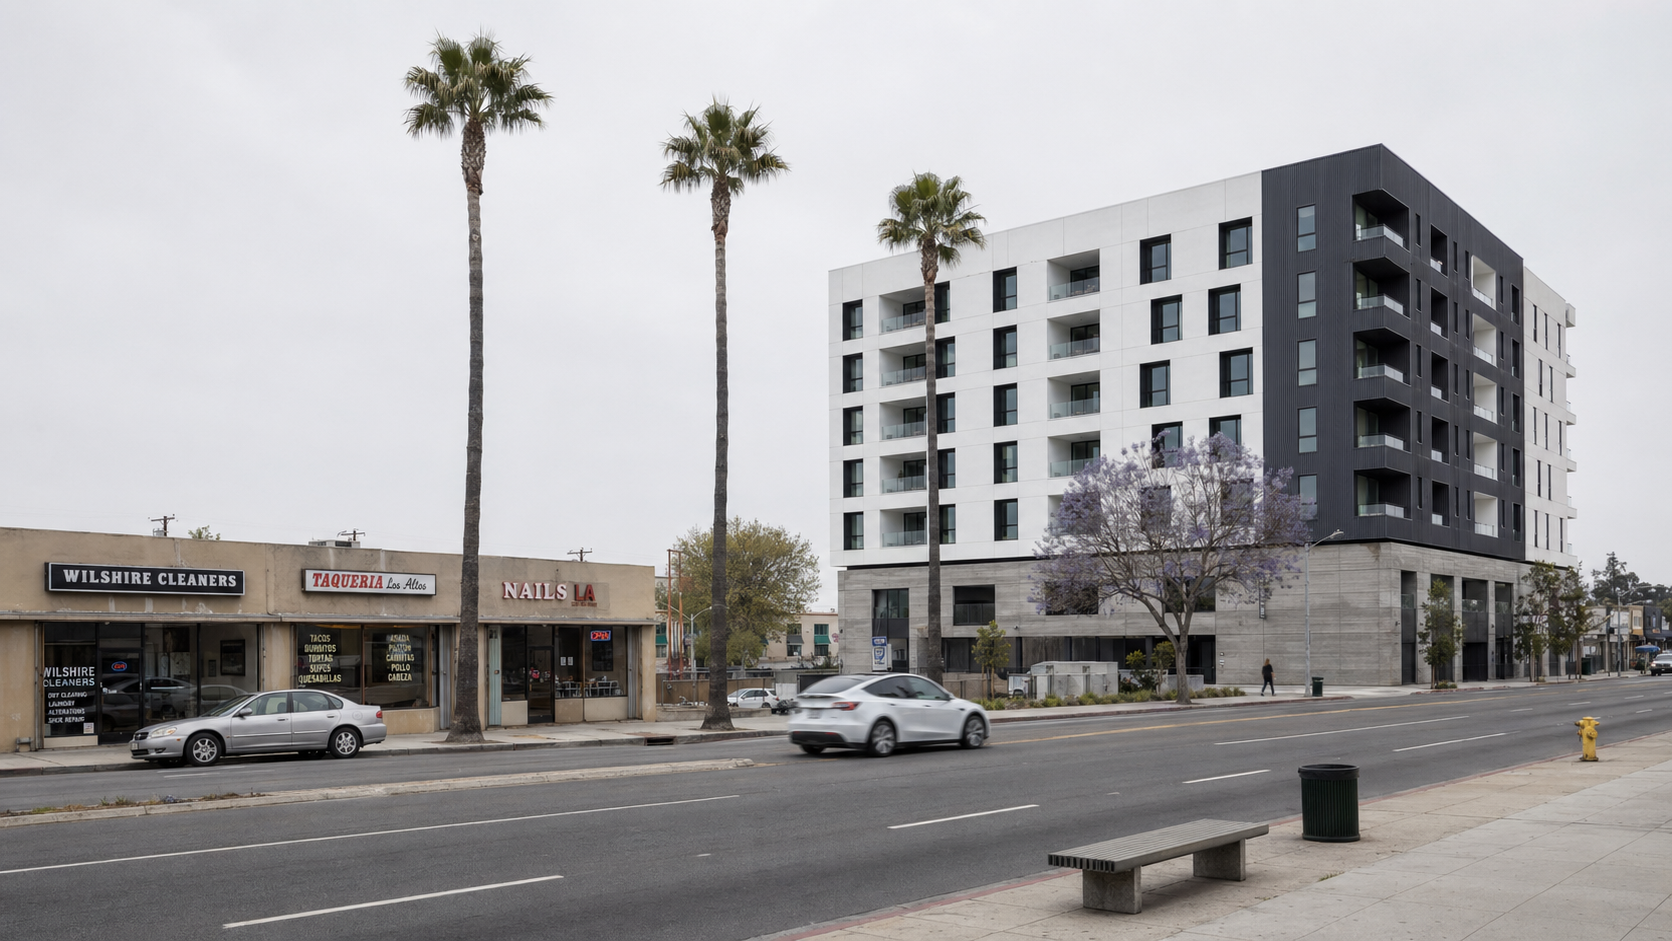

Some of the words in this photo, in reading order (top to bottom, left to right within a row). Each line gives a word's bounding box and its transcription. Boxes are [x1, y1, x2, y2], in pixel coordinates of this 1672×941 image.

[63, 569, 151, 585] WILSHIRE
[158, 573, 236, 587] CLEANERS
[313, 573, 383, 589] TAQUERIA
[386, 577, 400, 589] Los
[403, 578, 427, 590] Altos
[502, 582, 567, 600] NAILS
[574, 584, 596, 601] LA
[310, 634, 331, 642] TACOS
[391, 663, 410, 671] POLLO
[43, 678, 95, 687] CLEANERS
